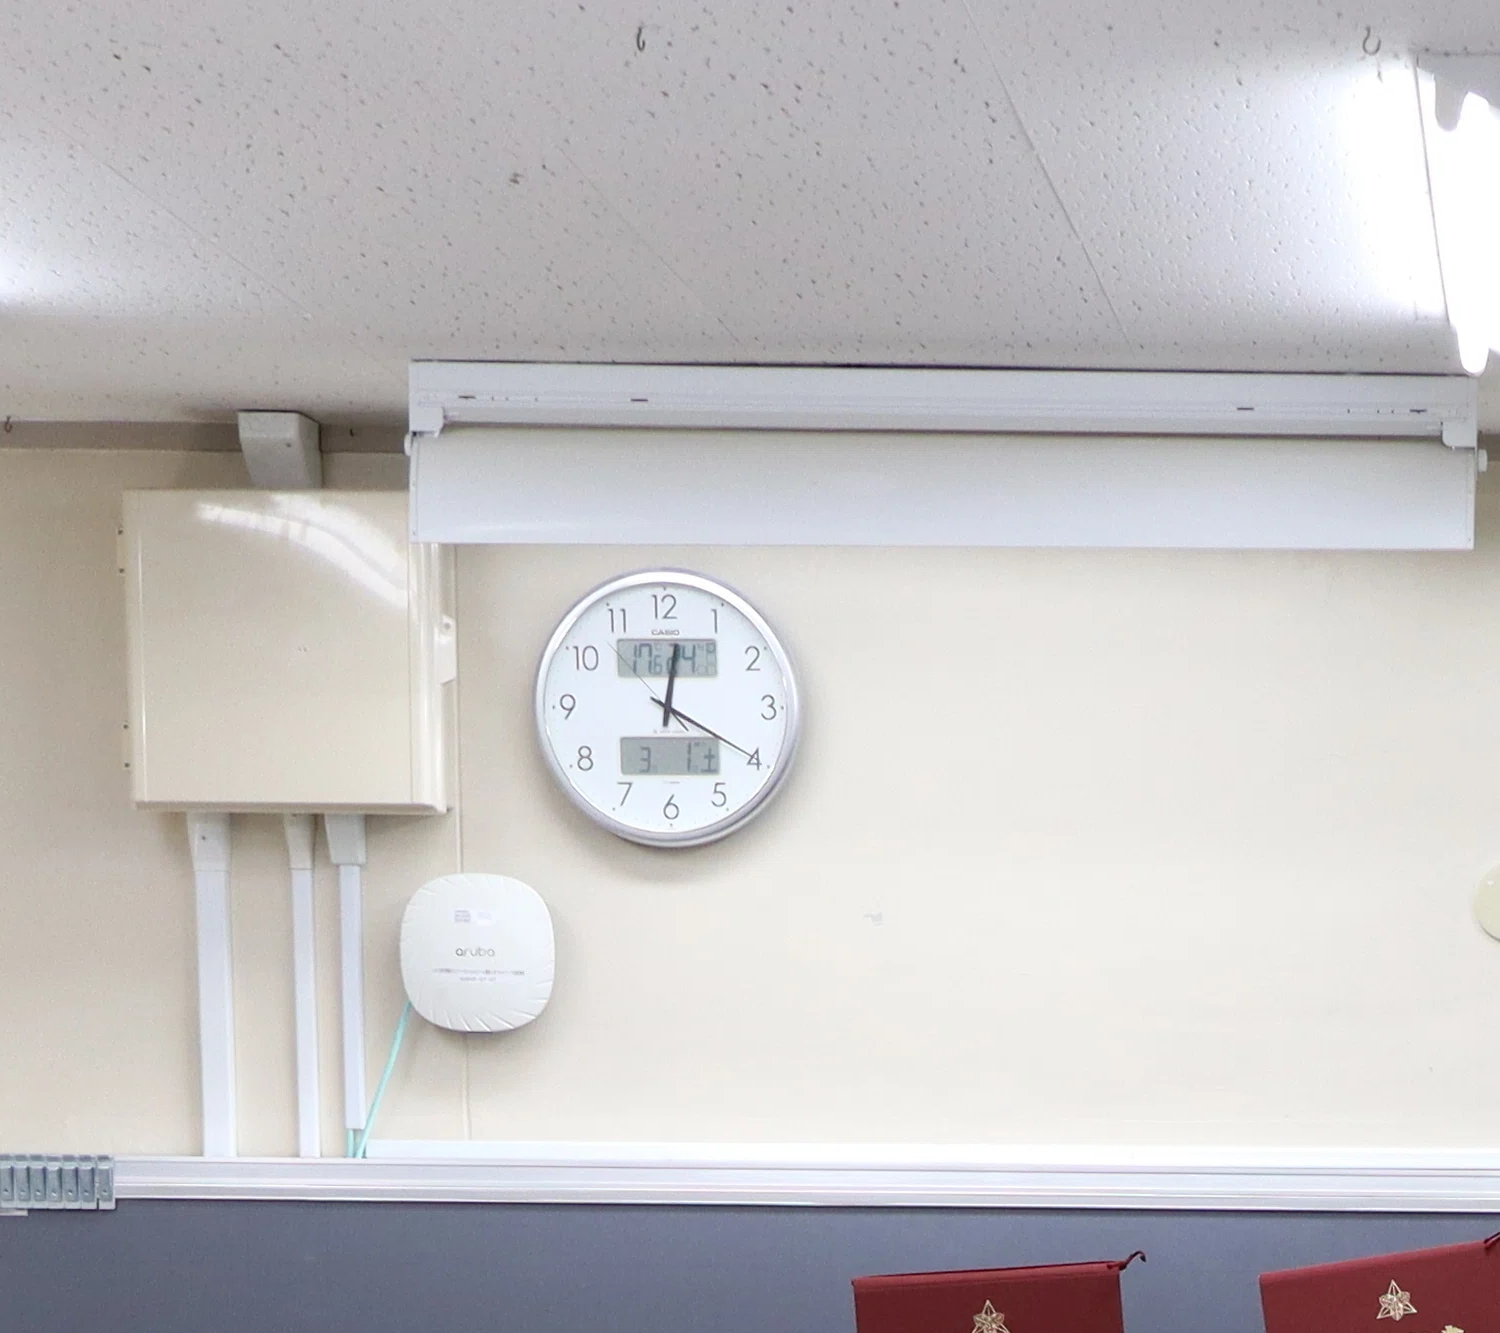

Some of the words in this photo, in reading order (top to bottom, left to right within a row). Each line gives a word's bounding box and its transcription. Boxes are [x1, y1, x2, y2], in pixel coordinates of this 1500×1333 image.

[652, 595, 677, 619] 12
[608, 609, 627, 633] 11
[712, 609, 717, 633] 1
[573, 645, 599, 671] 10
[745, 645, 761, 671] 2
[560, 694, 575, 720] 9
[761, 695, 777, 720] 3
[577, 746, 593, 771] 8
[617, 782, 633, 806] 7
[663, 794, 679, 819] 6
[712, 782, 727, 807] 5
[455, 948, 495, 957] aruba
